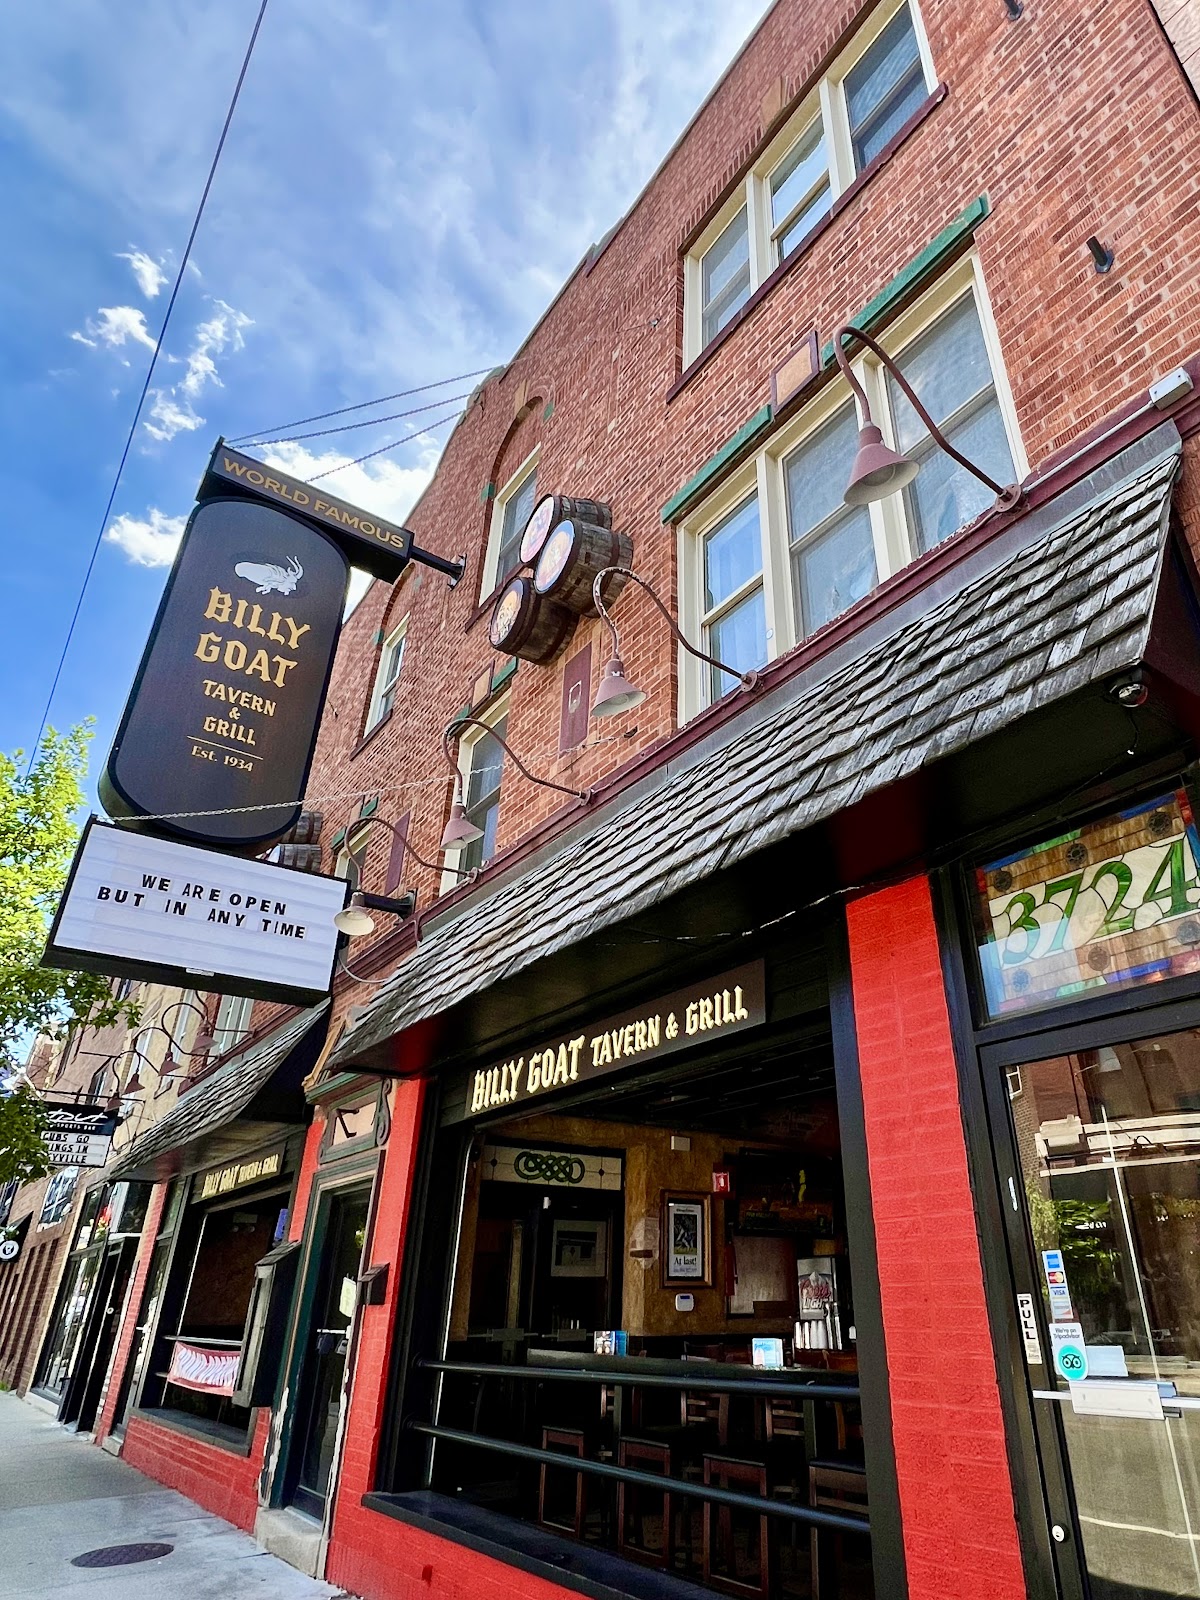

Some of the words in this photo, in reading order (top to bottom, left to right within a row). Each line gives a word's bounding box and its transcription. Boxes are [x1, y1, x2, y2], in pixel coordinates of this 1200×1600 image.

[223, 457, 310, 505] WORLD
[314, 500, 404, 549] FAMOUS
[203, 585, 311, 649] BILLY
[194, 631, 298, 688] GOAT
[202, 679, 277, 717] TAVERN
[228, 706, 241, 721] &
[203, 716, 256, 746] GRILL
[191, 744, 218, 762] Est.
[223, 755, 254, 772] 1934
[97, 886, 145, 907] BUT
[164, 899, 188, 916] IN
[207, 908, 247, 927] ANY
[261, 918, 306, 939] TIME
[142, 873, 171, 892] WE
[182, 883, 221, 902] ARE
[229, 893, 287, 916] OPEN
[1001, 839, 1198, 965] 3724
[470, 1057, 524, 1113] BILLY
[526, 1034, 586, 1094] GOAT
[589, 1013, 661, 1067] TAVERN
[665, 1012, 679, 1040] &
[684, 984, 749, 1036] GRILL
[42, 1132, 69, 1142] CUBS
[76, 1134, 90, 1144] GO
[49, 1143, 74, 1153] INGS
[49, 1153, 87, 1164] YVILLE
[1020, 1299, 1035, 1340] PULL
